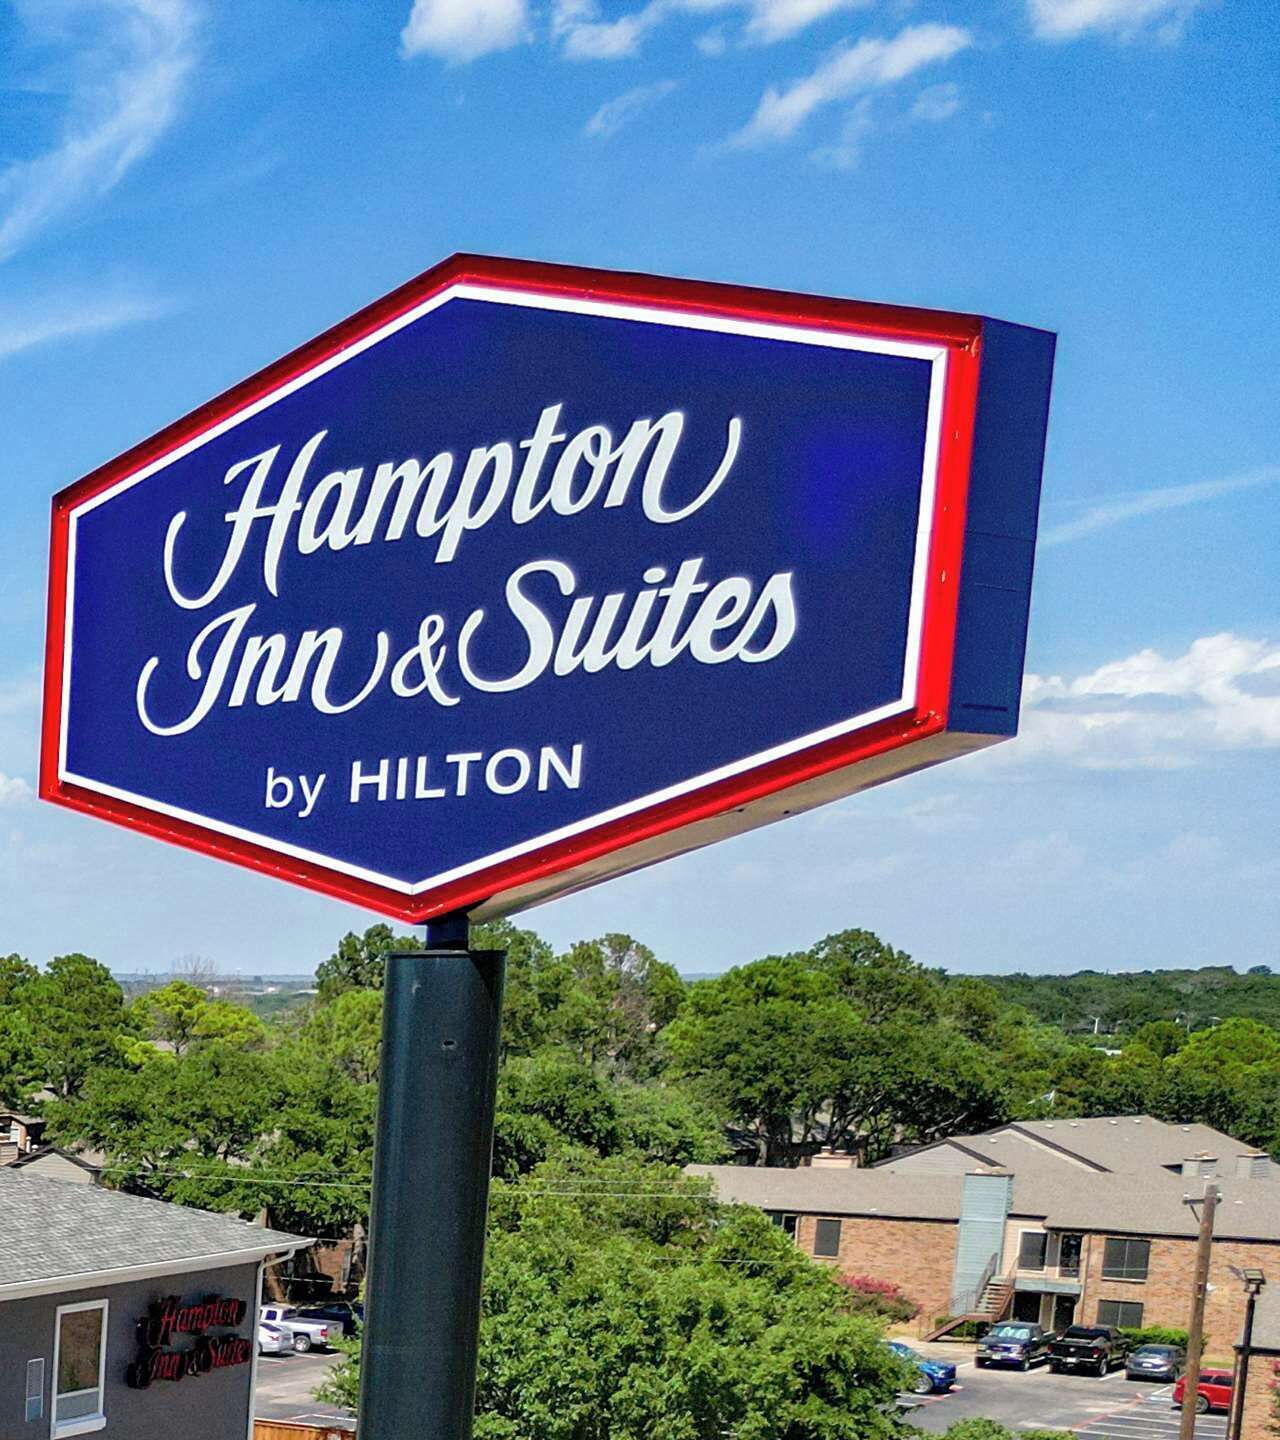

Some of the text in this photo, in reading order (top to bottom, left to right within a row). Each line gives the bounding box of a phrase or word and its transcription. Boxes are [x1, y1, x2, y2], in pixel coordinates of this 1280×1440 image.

[164, 403, 741, 609] Hampton
[137, 557, 797, 737] Inn & Suites
[266, 743, 583, 818] by HILTON
[137, 1295, 247, 1350] Hampton
[128, 1348, 189, 1389] Inn
